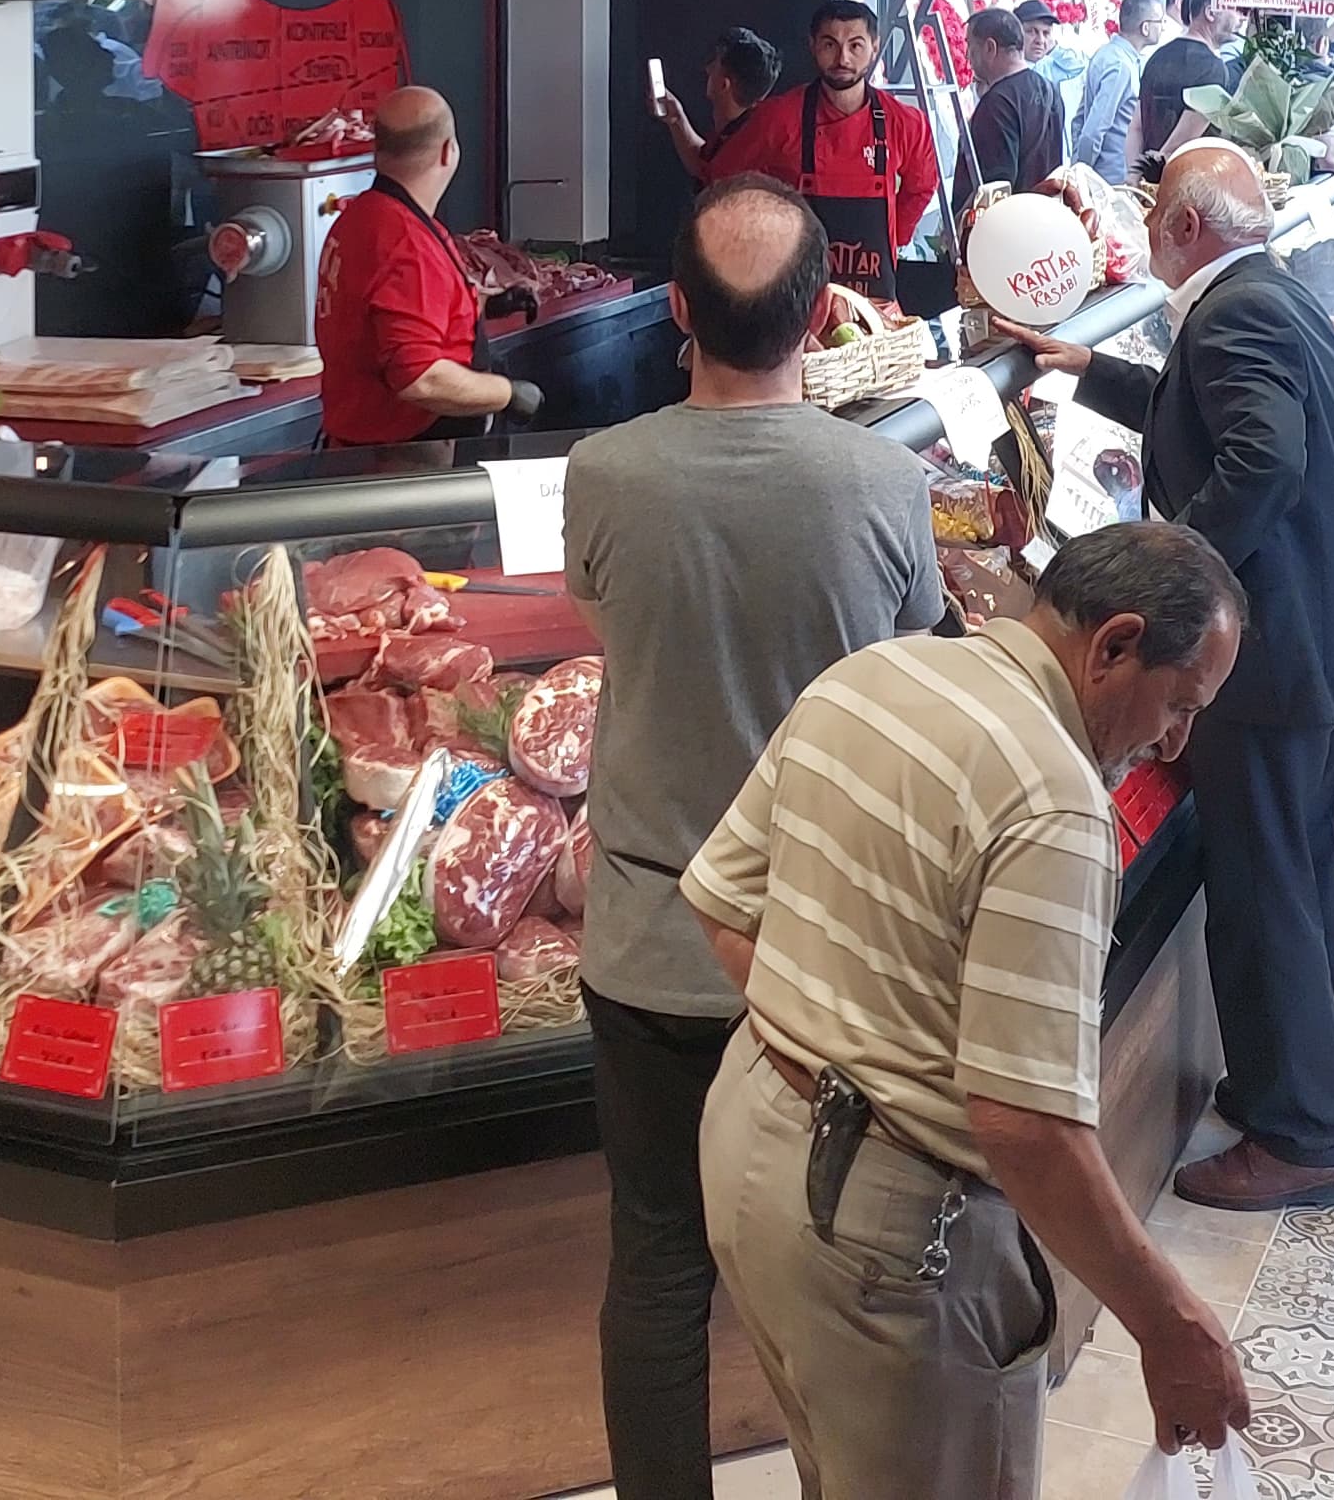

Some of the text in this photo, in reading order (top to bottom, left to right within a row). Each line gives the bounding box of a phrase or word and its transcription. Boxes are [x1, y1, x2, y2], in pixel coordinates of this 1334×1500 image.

[829, 241, 881, 278] NTAR
[1007, 250, 1081, 297] KANTAR
[1030, 276, 1079, 308] KASABI
